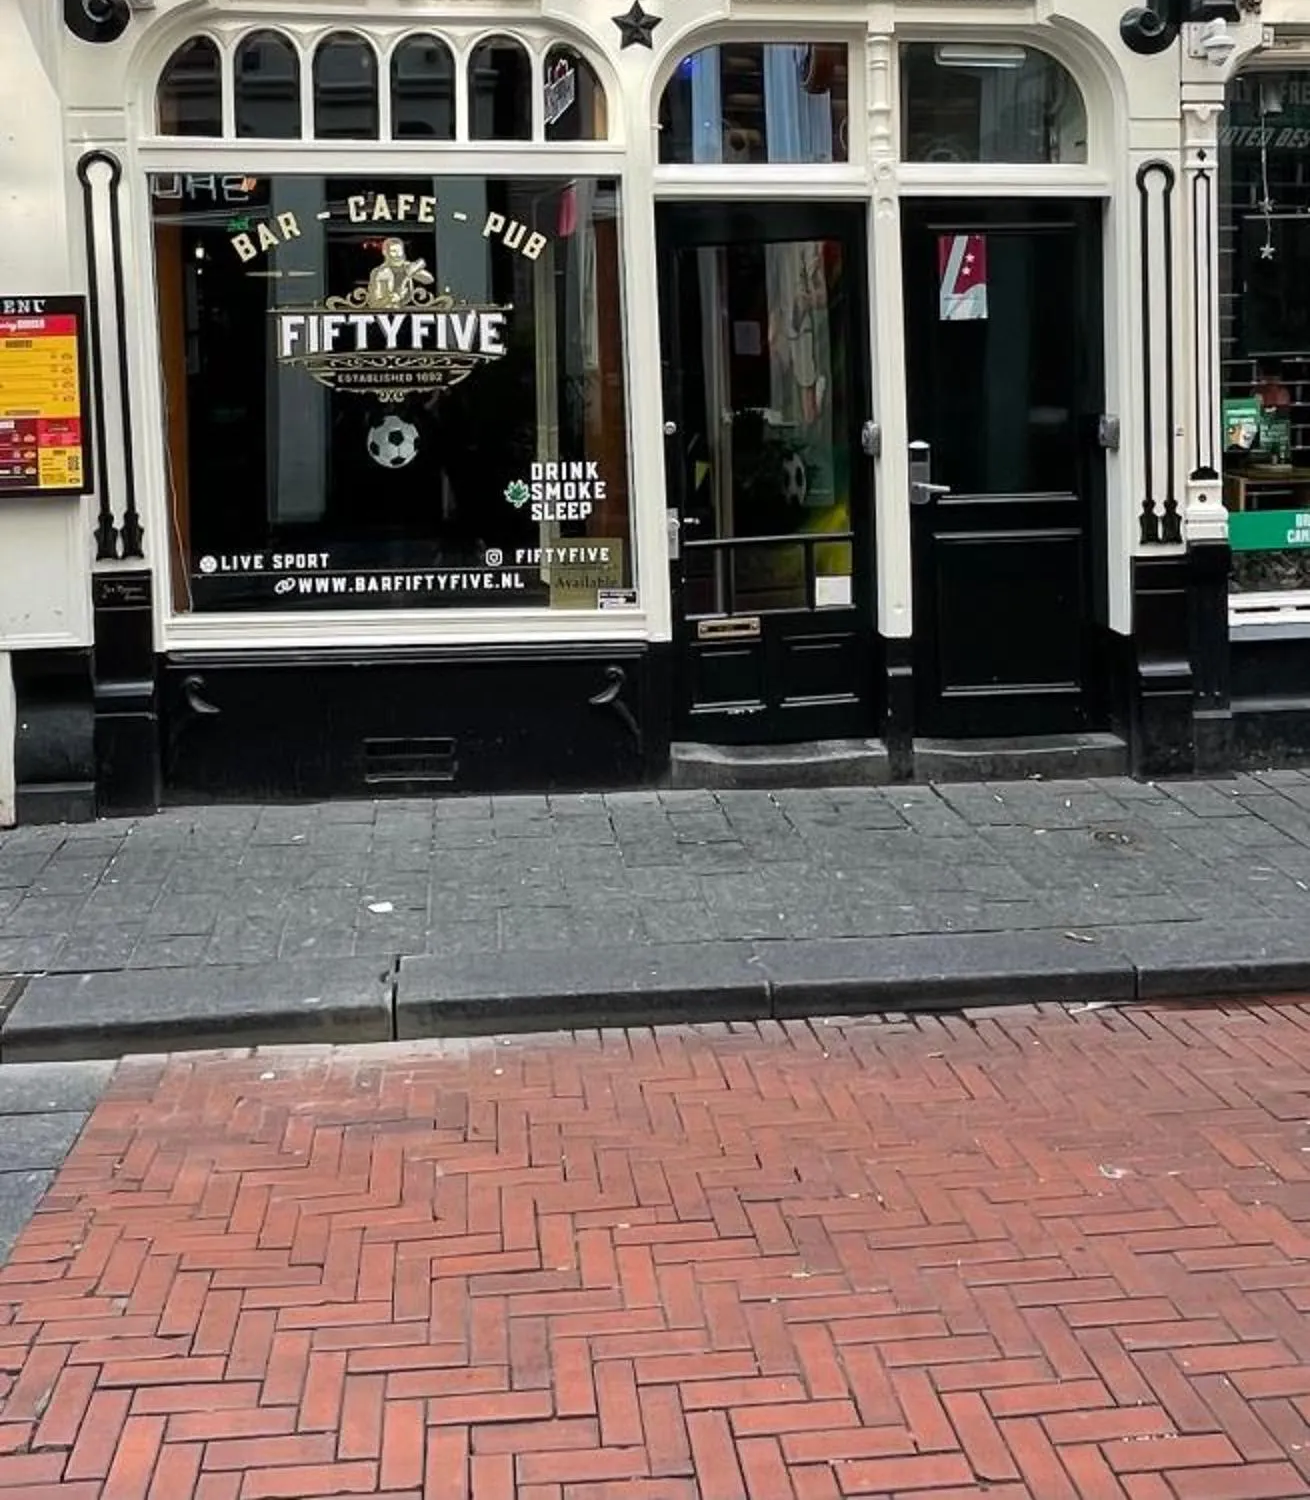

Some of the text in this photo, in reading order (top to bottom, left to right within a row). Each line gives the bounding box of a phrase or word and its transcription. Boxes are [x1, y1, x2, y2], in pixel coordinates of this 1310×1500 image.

[231, 211, 301, 263] BAR
[348, 194, 436, 223] CAFE
[482, 211, 547, 261] PUB
[2, 299, 46, 313] ENU
[279, 311, 507, 358] FIFTYFIVE
[337, 372, 413, 384] ESTABLISHED
[531, 462, 598, 481] DRINK
[531, 481, 606, 500] SMOKE
[531, 501, 592, 521] SLEEP
[221, 553, 329, 571] LIVE SPORT
[515, 547, 610, 564] FIFTYFIVE
[299, 572, 525, 593] WWW.BARFIFTYFIVE.NL
